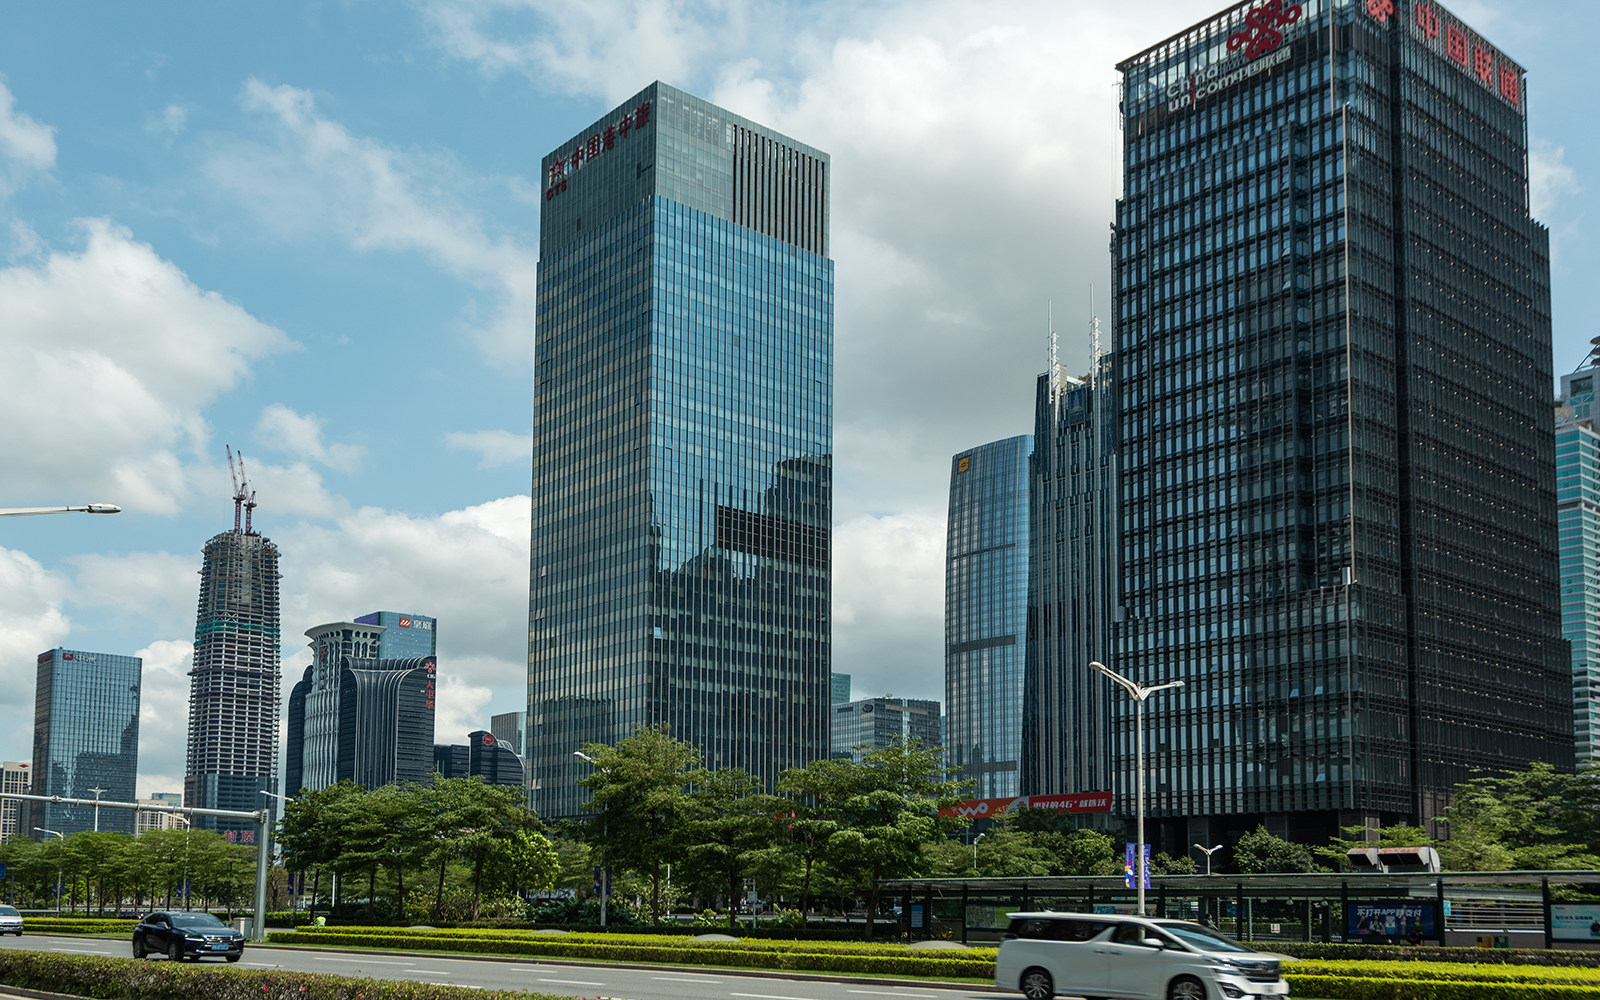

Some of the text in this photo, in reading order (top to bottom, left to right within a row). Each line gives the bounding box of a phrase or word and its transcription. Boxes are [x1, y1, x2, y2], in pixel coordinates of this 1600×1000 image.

[1417, 3, 1519, 105] 中国联通
[571, 101, 650, 170] 中国港中旅
[546, 179, 567, 200] CTS
[224, 830, 254, 842] 封顶
